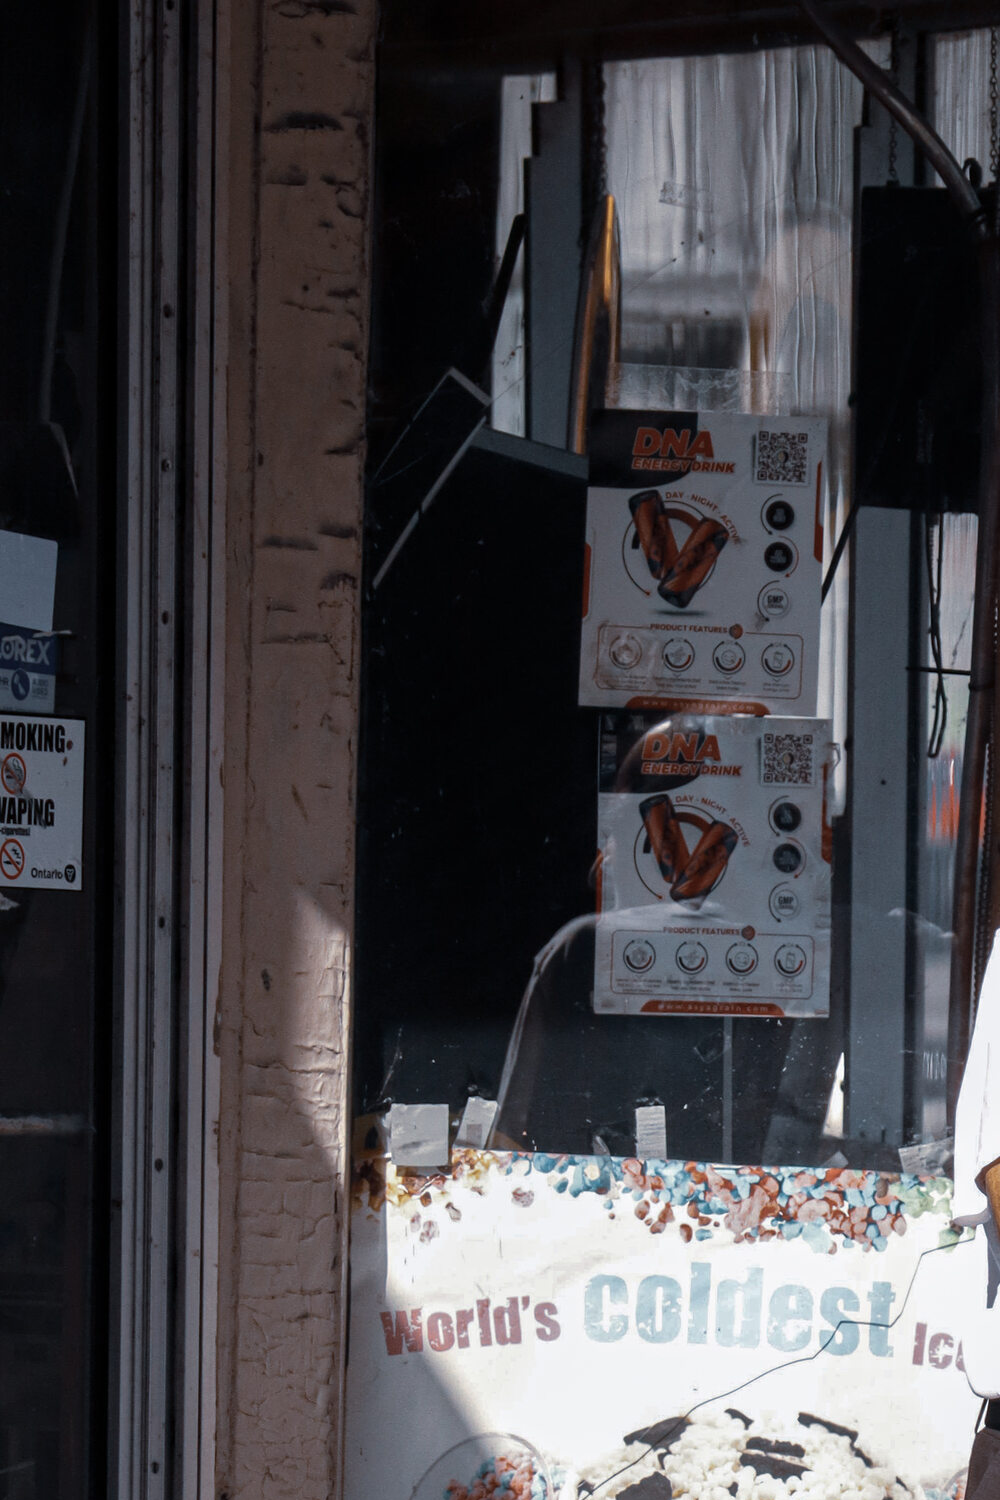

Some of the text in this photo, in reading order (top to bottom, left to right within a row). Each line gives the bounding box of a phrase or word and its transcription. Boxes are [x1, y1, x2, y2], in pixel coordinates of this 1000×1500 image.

[632, 427, 715, 459] DNA
[632, 458, 736, 474] ENERGY DRINK
[665, 491, 684, 500] DAY
[690, 493, 718, 512] NIGHT
[650, 623, 728, 634] PRODUCT FEATURES
[0, 634, 50, 666] OREX
[640, 732, 722, 763] DNA
[641, 762, 742, 777] ENERGY DRINK
[675, 794, 694, 803] DAY
[701, 797, 727, 814] NIGHT
[31, 867, 64, 880] Ontario
[663, 926, 740, 937] PRODUCT FEATURES
[380, 1295, 562, 1356] World's
[912, 1321, 966, 1373] Ic
